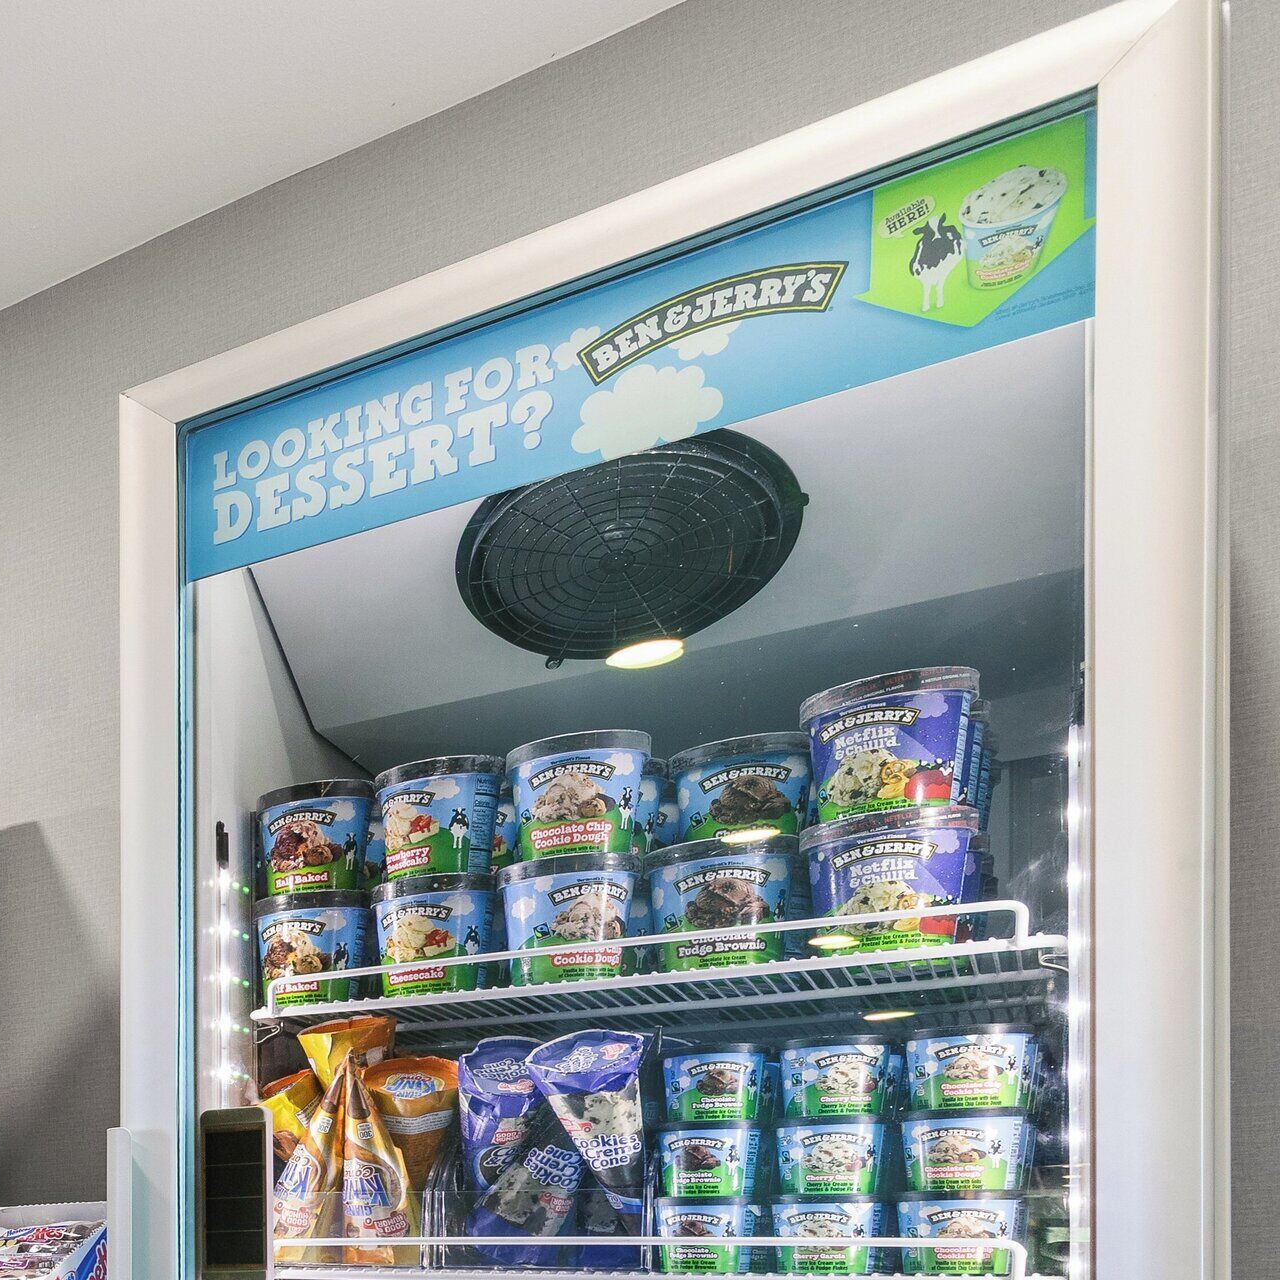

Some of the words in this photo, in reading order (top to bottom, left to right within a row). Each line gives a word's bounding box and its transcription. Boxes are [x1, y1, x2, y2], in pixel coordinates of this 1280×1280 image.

[885, 198, 926, 226] Available
[887, 204, 931, 235] HERE!
[212, 380, 434, 491] LOOKING
[444, 343, 555, 415] FOR
[212, 390, 554, 545] DESSERT?
[834, 726, 896, 749] Netflix
[530, 826, 584, 841] Chocolate
[587, 821, 613, 836] Chip
[535, 834, 567, 849] Cookie
[569, 831, 609, 846] Dough
[849, 858, 915, 878] Netflix
[295, 872, 328, 886] Baked
[678, 943, 714, 957] Fudge
[715, 939, 767, 953] Brownie
[552, 953, 593, 965] Cookie
[389, 968, 445, 984] Cheesecake
[591, 1153, 630, 1170] Cone
